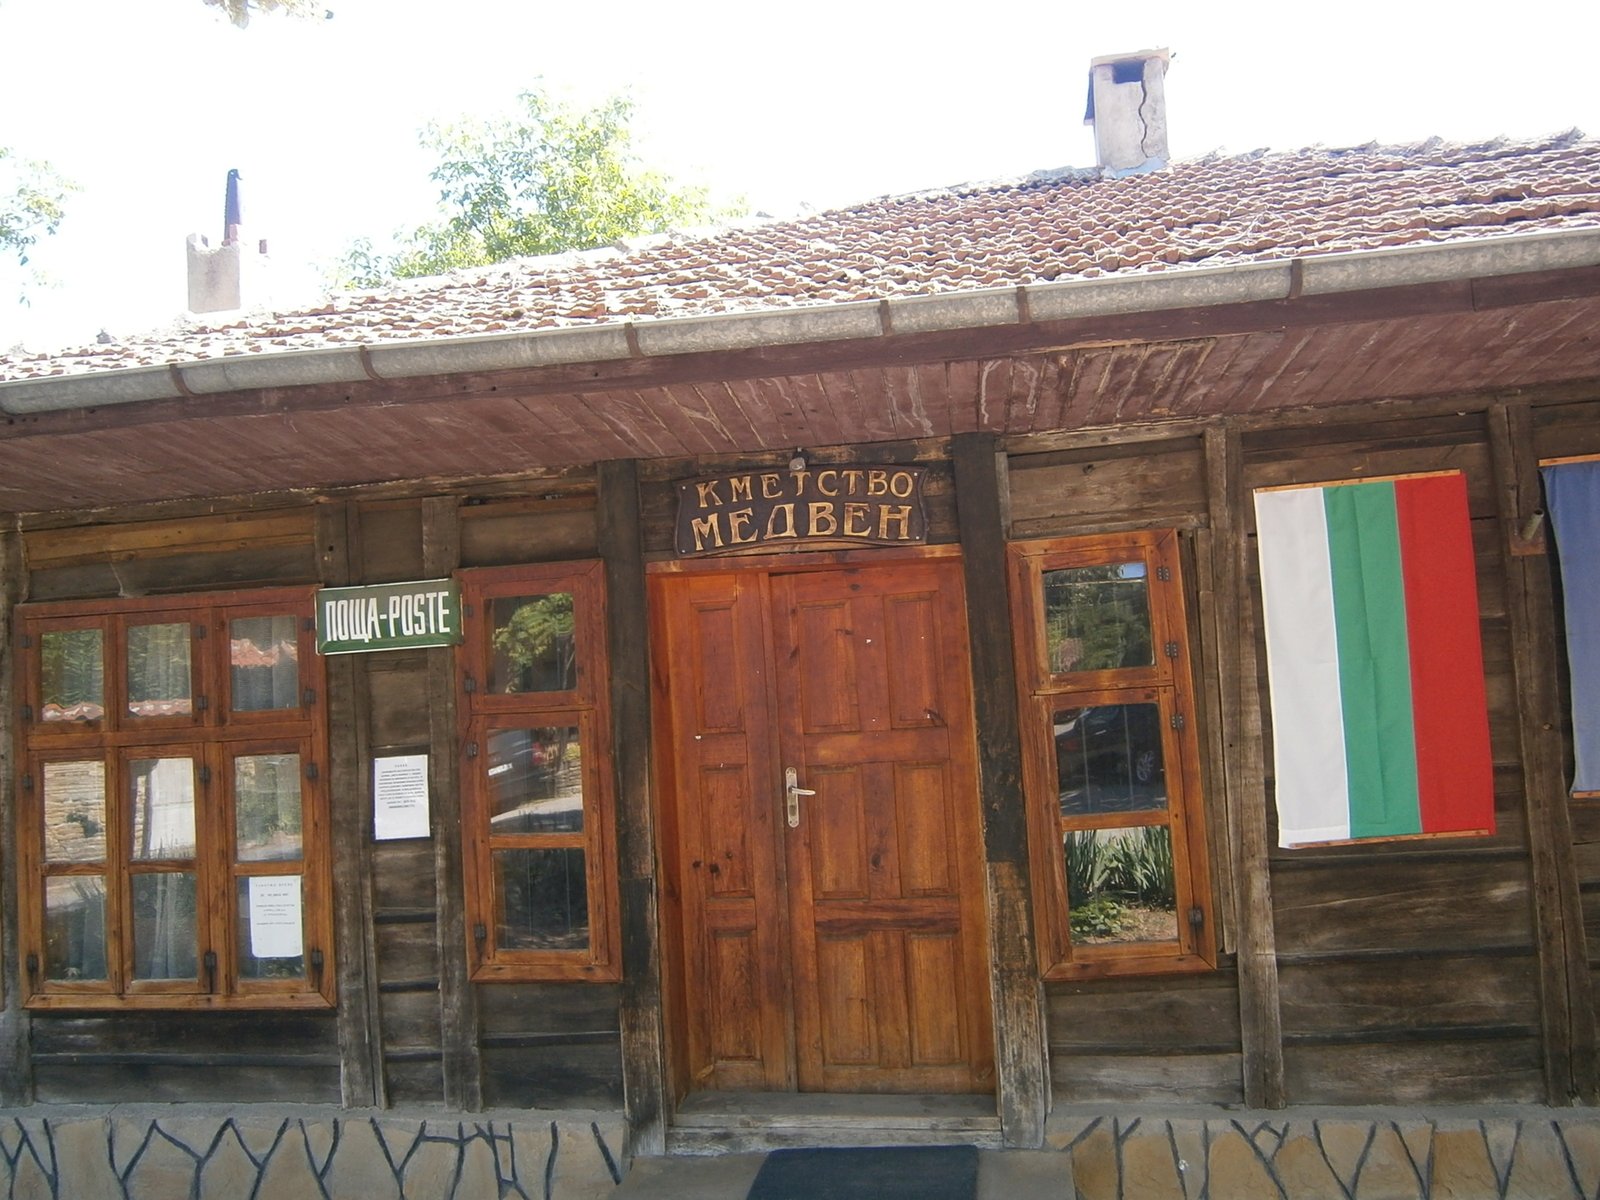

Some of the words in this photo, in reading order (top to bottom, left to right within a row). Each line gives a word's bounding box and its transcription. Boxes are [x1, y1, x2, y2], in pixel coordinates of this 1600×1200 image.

[696, 470, 913, 508] КМЕТСТВО
[691, 503, 912, 551] МЕДВЕН
[326, 591, 450, 642] ПОЩА-POSTE
